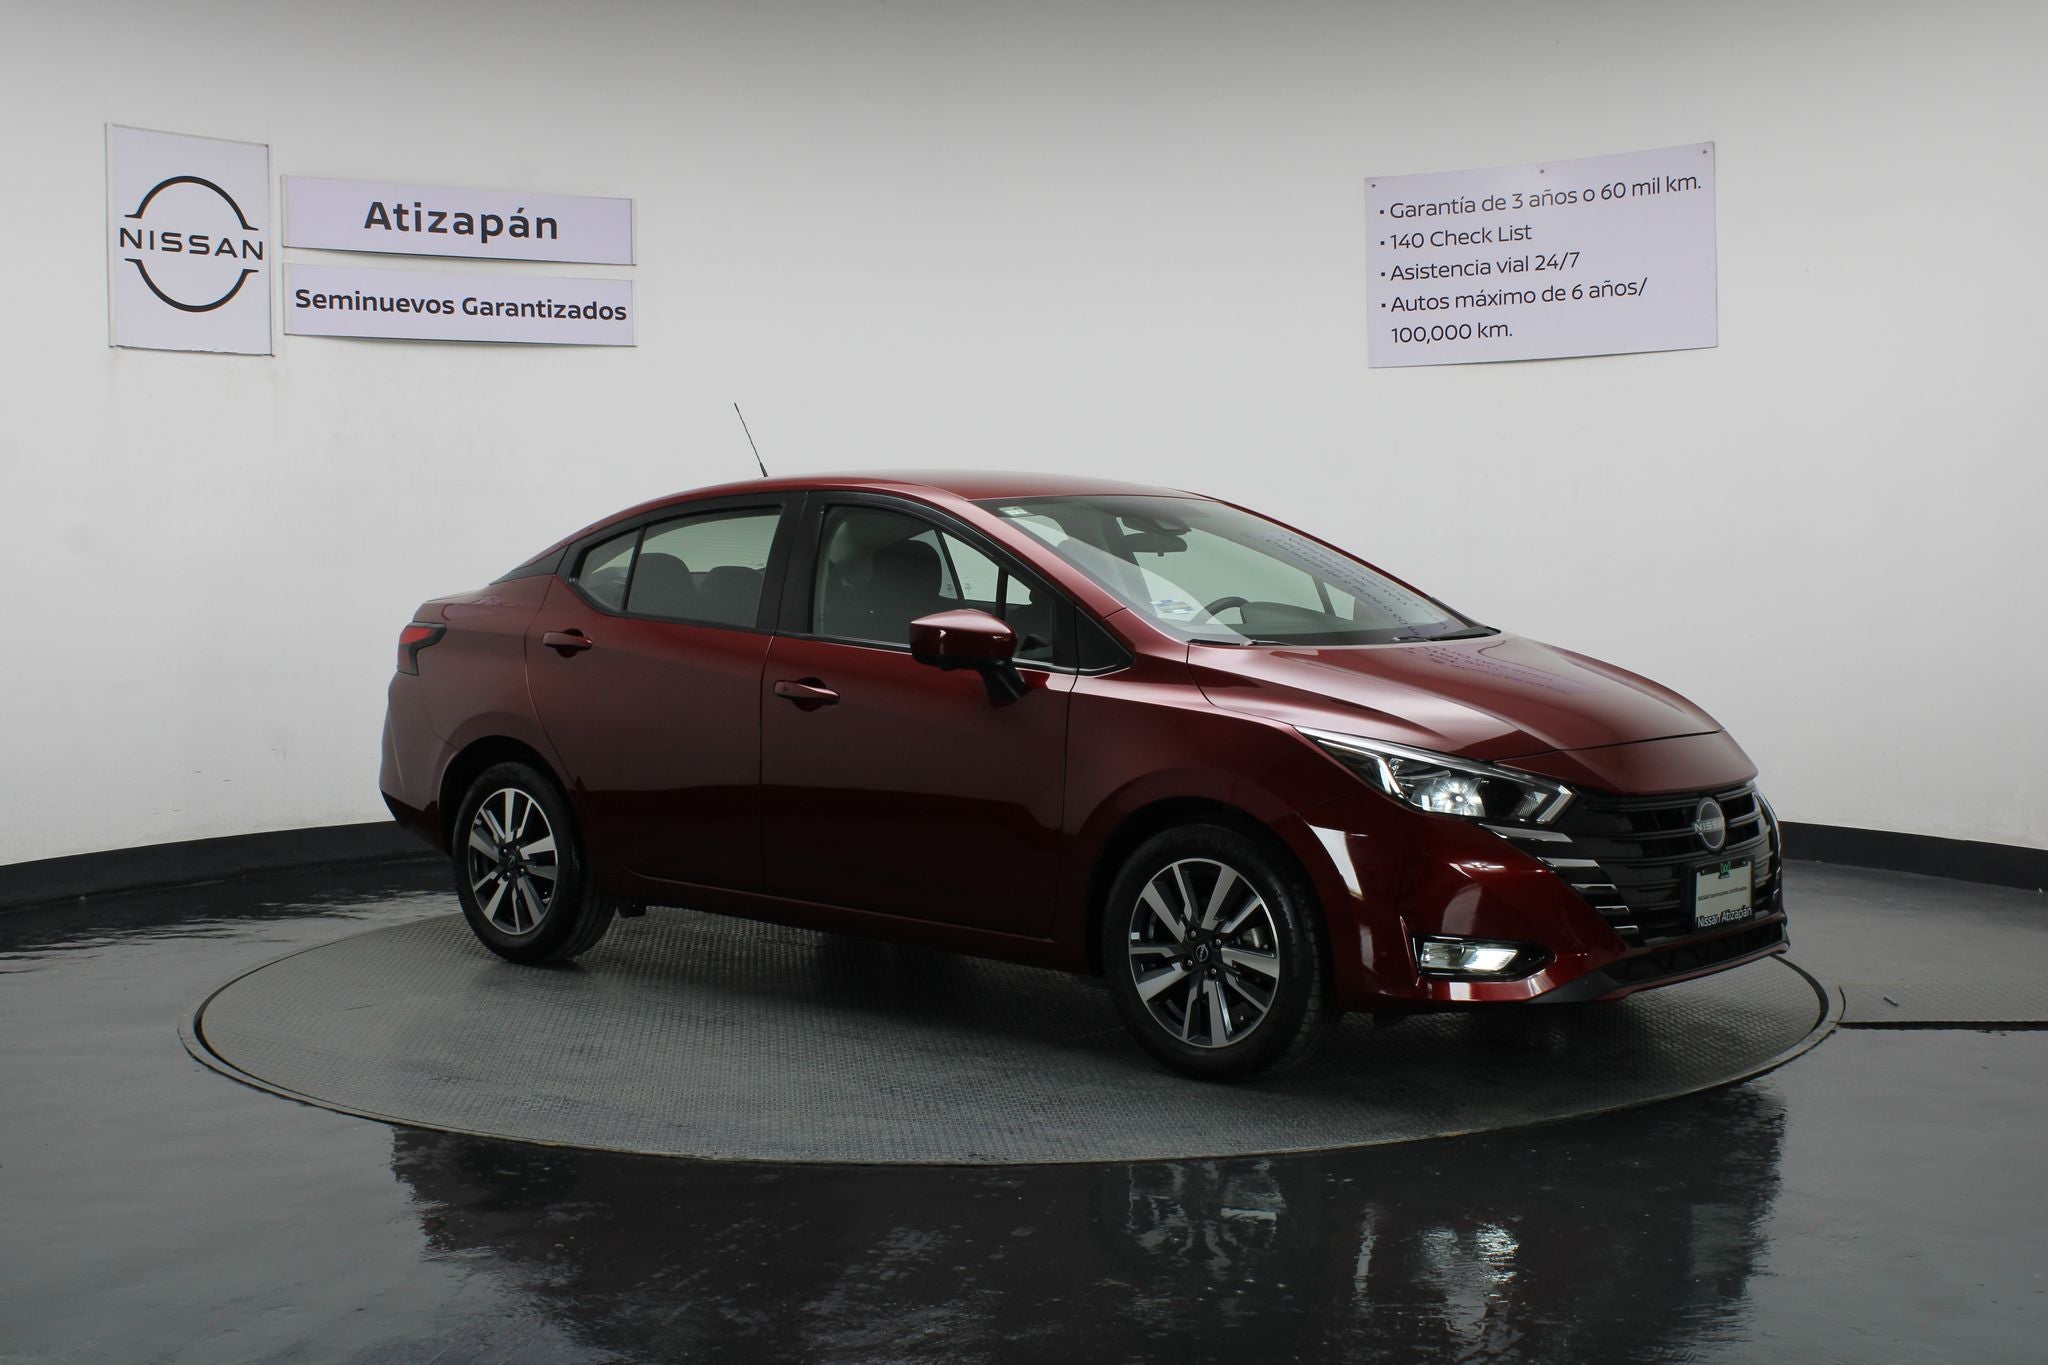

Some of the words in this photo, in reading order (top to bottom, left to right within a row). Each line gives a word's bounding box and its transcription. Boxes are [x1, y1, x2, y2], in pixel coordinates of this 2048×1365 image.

[1389, 195, 1476, 219] Garantía
[1481, 194, 1507, 212] de
[1511, 192, 1524, 210] 3
[1528, 188, 1579, 208] años
[1582, 188, 1596, 203] o
[1600, 181, 1627, 201] 60
[1631, 176, 1661, 199] mil
[1666, 175, 1702, 193] km.
[363, 201, 558, 244] Atizapán
[1389, 232, 1425, 250] 140
[1429, 226, 1494, 248] Check
[1498, 224, 1533, 243] List
[119, 227, 264, 261] NISSAN
[1390, 259, 1492, 282] Asistencia
[1495, 255, 1531, 274] vial
[1534, 251, 1581, 272] 24/7
[295, 288, 455, 317] Seminuevos
[461, 296, 627, 321] Garantizados
[1390, 295, 1450, 313] Autos
[1455, 288, 1537, 309] máximo
[1541, 284, 1567, 303] de
[1571, 283, 1584, 301] 6
[1588, 276, 1648, 301] años/
[1391, 323, 1472, 345] 100,000
[1477, 321, 1513, 339] km.
[1697, 914, 1721, 928] Nissan
[1721, 907, 1752, 923] Atizapán
